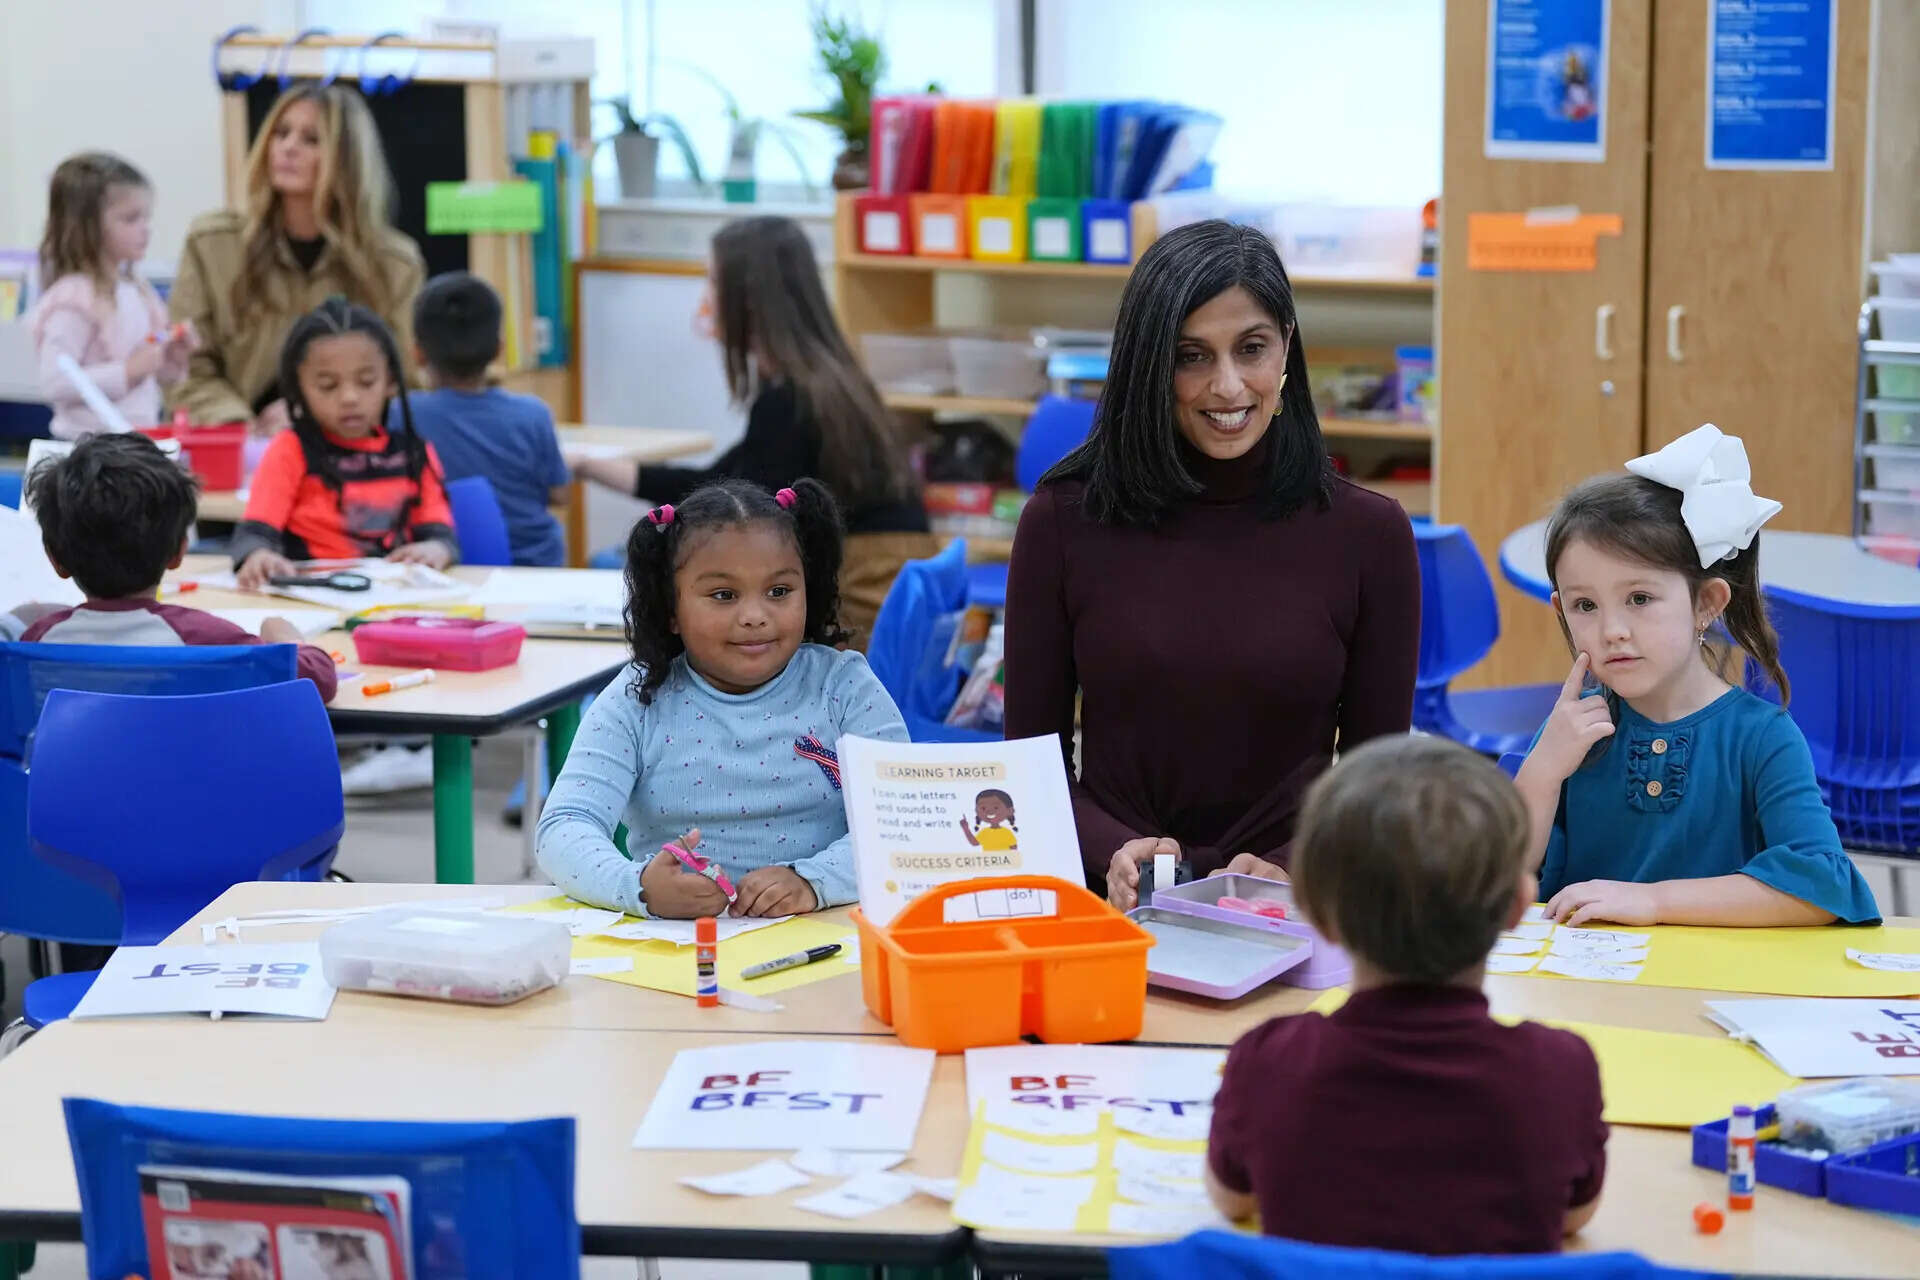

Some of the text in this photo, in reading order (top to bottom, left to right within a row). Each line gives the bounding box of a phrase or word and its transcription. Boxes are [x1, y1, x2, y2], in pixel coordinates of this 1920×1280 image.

[884, 766, 997, 778] LEARNING TARGET
[920, 790, 957, 800] letters
[896, 804, 932, 814] sounds
[936, 805, 947, 814] to
[877, 817, 952, 829] read and write
[896, 855, 1012, 870] SUCCESS CRITERIA
